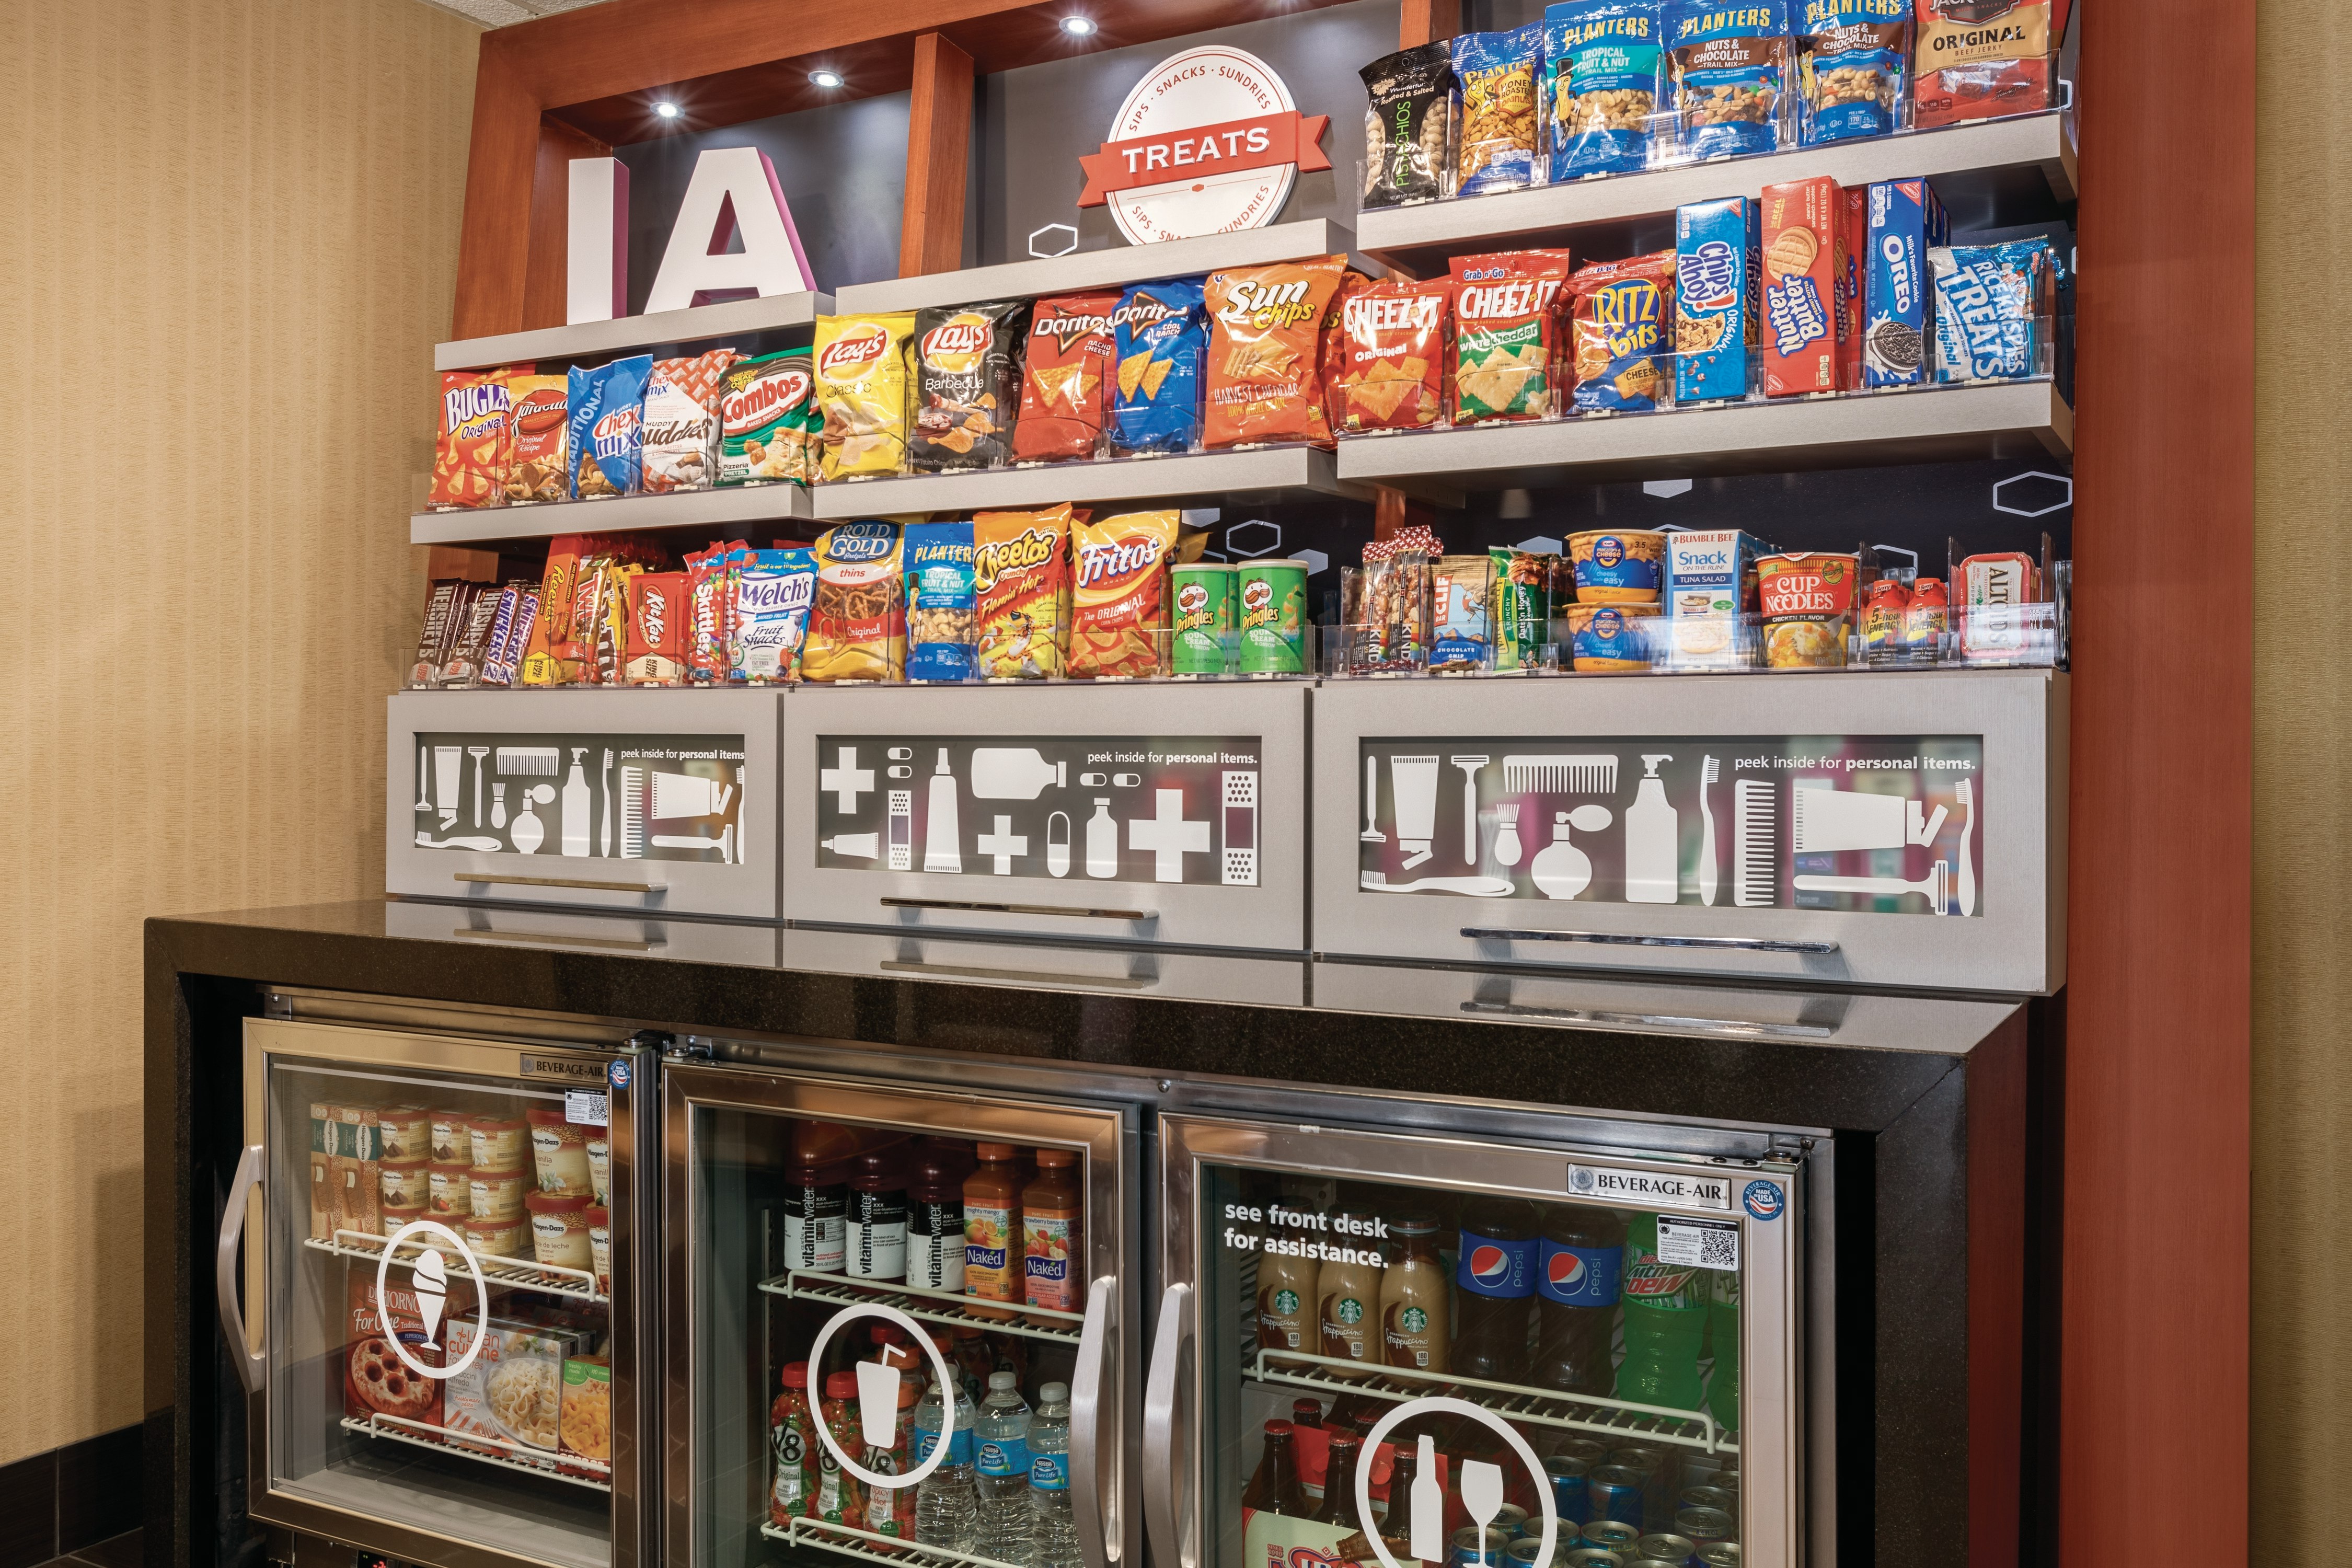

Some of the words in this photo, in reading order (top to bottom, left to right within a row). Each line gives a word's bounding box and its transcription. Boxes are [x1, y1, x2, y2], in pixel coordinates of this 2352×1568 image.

[1564, 17, 1649, 49] PLANTERS
[1681, 8, 1771, 39] PLANTERS
[1705, 39, 1730, 52] NUTS
[1731, 39, 1739, 50] &
[1823, 33, 1879, 50] CHOCOLATE
[1933, 26, 2025, 51] ORIGINAL
[1978, 44, 2002, 53] JERKY
[1582, 47, 1625, 61] TROPICAL
[1693, 50, 1750, 64] CHOCOLATE
[1833, 46, 1852, 54] TRAIL
[1577, 57, 1600, 73] FRUIT
[1601, 58, 1609, 67] &
[1611, 57, 1630, 67] NUT
[1501, 78, 1531, 90] HONEY
[1502, 87, 1531, 98] ROASTED
[1129, 103, 1149, 132] SIPS
[1156, 65, 1206, 96] SNACKS
[1219, 66, 1271, 109] SUNDRIES
[1122, 127, 1270, 174] TREATS
[1906, 235, 1914, 255] Milk's
[1883, 235, 1910, 314] OREO
[1219, 280, 1309, 321] Sun
[1596, 285, 1657, 336] RITZ
[1784, 276, 1824, 340] Butter
[1715, 309, 1738, 353] ORIGINAL
[1769, 287, 1804, 355] Nutter
[1937, 266, 2003, 377] TREATS
[822, 333, 885, 368] Lay's
[1088, 340, 1111, 351] NACHO
[1607, 324, 1658, 358] bits
[1626, 368, 1658, 380] CHEESE
[722, 376, 802, 423] Combos
[747, 419, 762, 428] BAKED
[763, 408, 781, 421] SNACKS
[516, 434, 547, 446] Original
[518, 444, 540, 453] Recipe
[841, 524, 890, 538] ROLD
[829, 537, 889, 557] GOLD
[975, 531, 1053, 594] Cheetos
[1077, 537, 1161, 589] Fritos
[1678, 551, 1727, 566] Snack
[839, 568, 866, 578] thins
[1103, 576, 1130, 586] BRAND
[1604, 577, 1624, 585] easy
[741, 576, 809, 606] Welch's
[1777, 576, 1820, 594] CUP
[1435, 577, 1450, 615] CLIF
[696, 583, 715, 656] Skittles
[1176, 607, 1214, 640] Pringles
[1242, 604, 1279, 637] Pringles
[1436, 614, 1446, 622] BAR
[743, 632, 785, 648] Snacks
[752, 625, 784, 637] Fruit
[847, 624, 881, 638] Original
[1185, 637, 1210, 645] CREAM
[1368, 630, 1381, 663] KIND
[1401, 624, 1411, 660] KIND
[621, 748, 639, 759] peek
[642, 749, 664, 758] inside
[666, 749, 678, 758] for
[679, 750, 718, 760] personal
[1088, 752, 1112, 764] peek
[1115, 752, 1145, 763] inside
[1148, 752, 1163, 763] for
[1166, 752, 1216, 765] personal
[1220, 752, 1257, 763] items.
[1735, 756, 1770, 770] peek
[1774, 756, 1815, 769] inside
[1819, 756, 1841, 769] for
[1846, 756, 1918, 771] personal
[1923, 756, 1976, 769] items.
[536, 1061, 604, 1077] BEVERAGE-AIR
[1598, 1174, 1721, 1200] BEVERAGE-AIR
[802, 1187, 815, 1267] vitaminwater
[1225, 1203, 1262, 1222] see
[1268, 1204, 1327, 1231] front
[1334, 1213, 1388, 1239] desk
[860, 1193, 872, 1274] vitaminwater
[928, 1204, 941, 1288] vitaminwater
[1224, 1227, 1259, 1250] for
[1264, 1236, 1389, 1269] assistance.
[967, 1249, 1000, 1265] Naked
[1028, 1260, 1061, 1276] Naked
[1514, 1249, 1524, 1288] pepsi
[1590, 1257, 1601, 1297] pepsi
[401, 1321, 423, 1330] Traditional
[447, 1378, 469, 1387] Alfredo
[778, 1469, 800, 1480] Original
